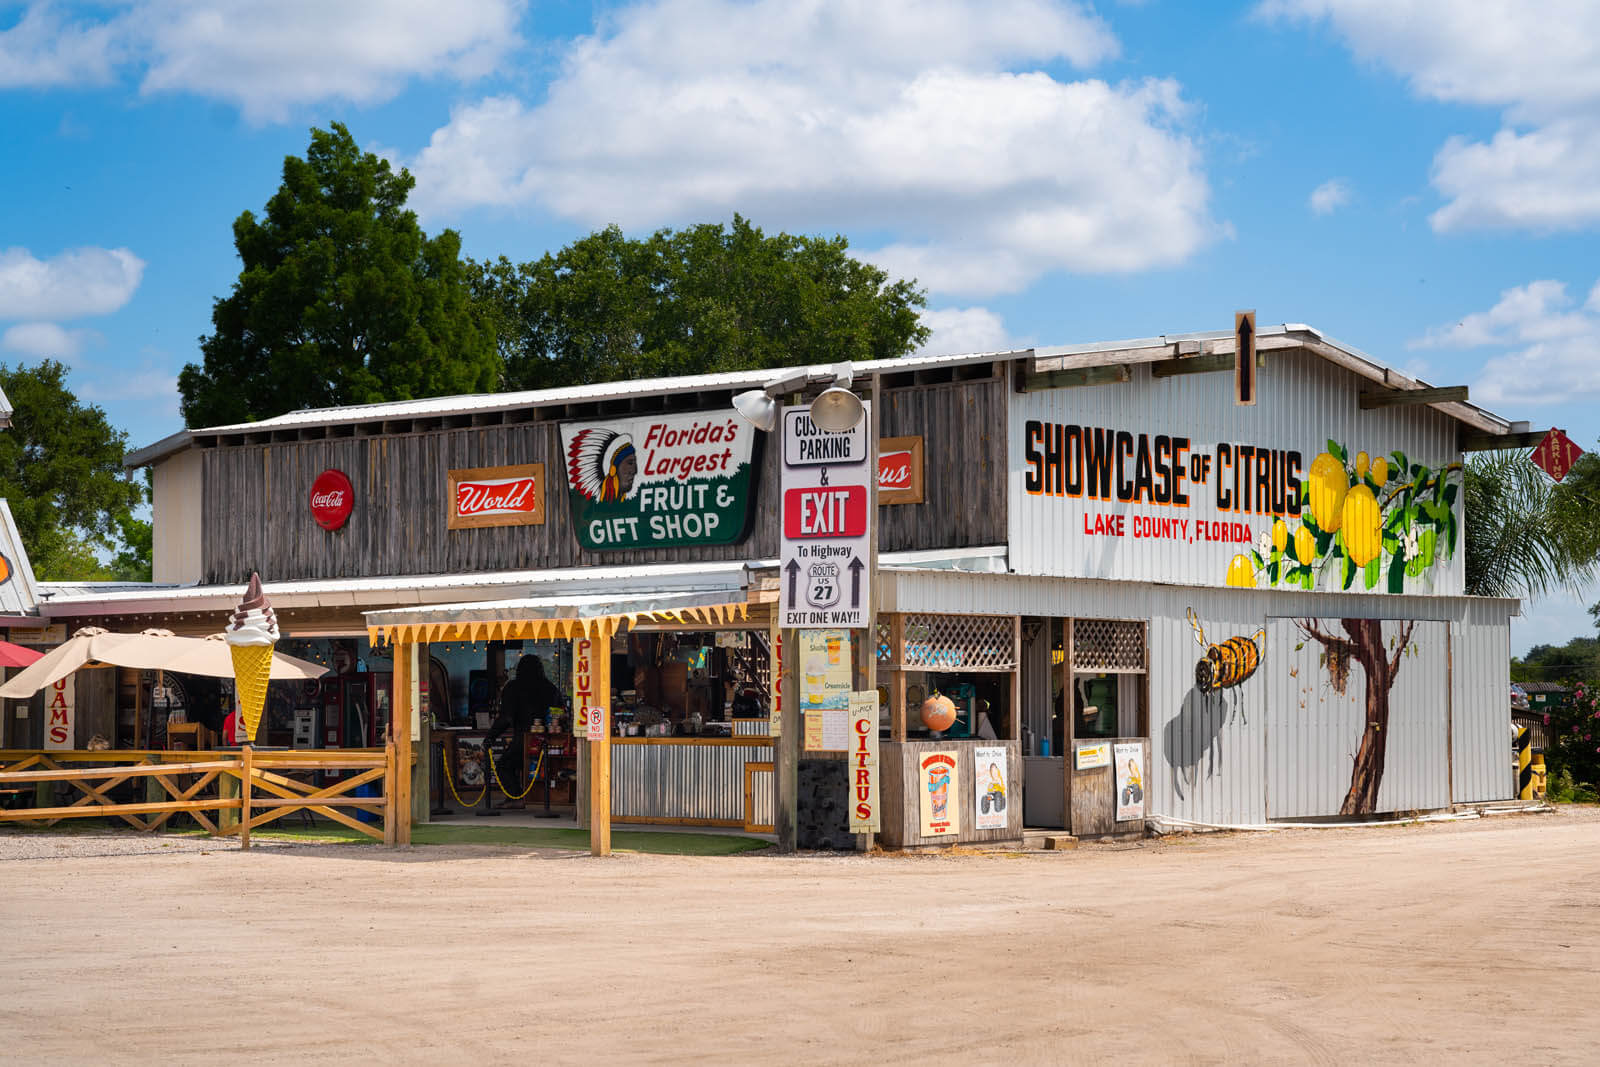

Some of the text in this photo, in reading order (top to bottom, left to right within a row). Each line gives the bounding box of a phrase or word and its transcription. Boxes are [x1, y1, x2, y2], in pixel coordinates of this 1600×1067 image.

[643, 419, 739, 450] Florida's
[800, 437, 851, 460] PARKING
[643, 448, 732, 481] Largest
[1550, 430, 1563, 479] PARKING
[820, 466, 829, 486] &
[1025, 420, 1302, 519] SHOWCASE OF CITRUS
[312, 490, 344, 508] Coca-Cola
[459, 480, 533, 512] World
[640, 484, 735, 512] FRUIT &
[800, 491, 849, 535] EXIT
[589, 512, 720, 544] GIFT SHOP
[1084, 513, 1253, 544] LAKE COUNTY, FLORIDA
[797, 545, 852, 559] To Highway
[812, 566, 835, 576] ROUTE
[814, 586, 833, 600] 27
[786, 612, 807, 624] EXIT
[809, 612, 829, 624] ONE
[831, 611, 860, 624] WAY!!
[852, 705, 873, 717] U-PICK
[591, 725, 601, 733] NO
[855, 718, 872, 821] CITRUS
